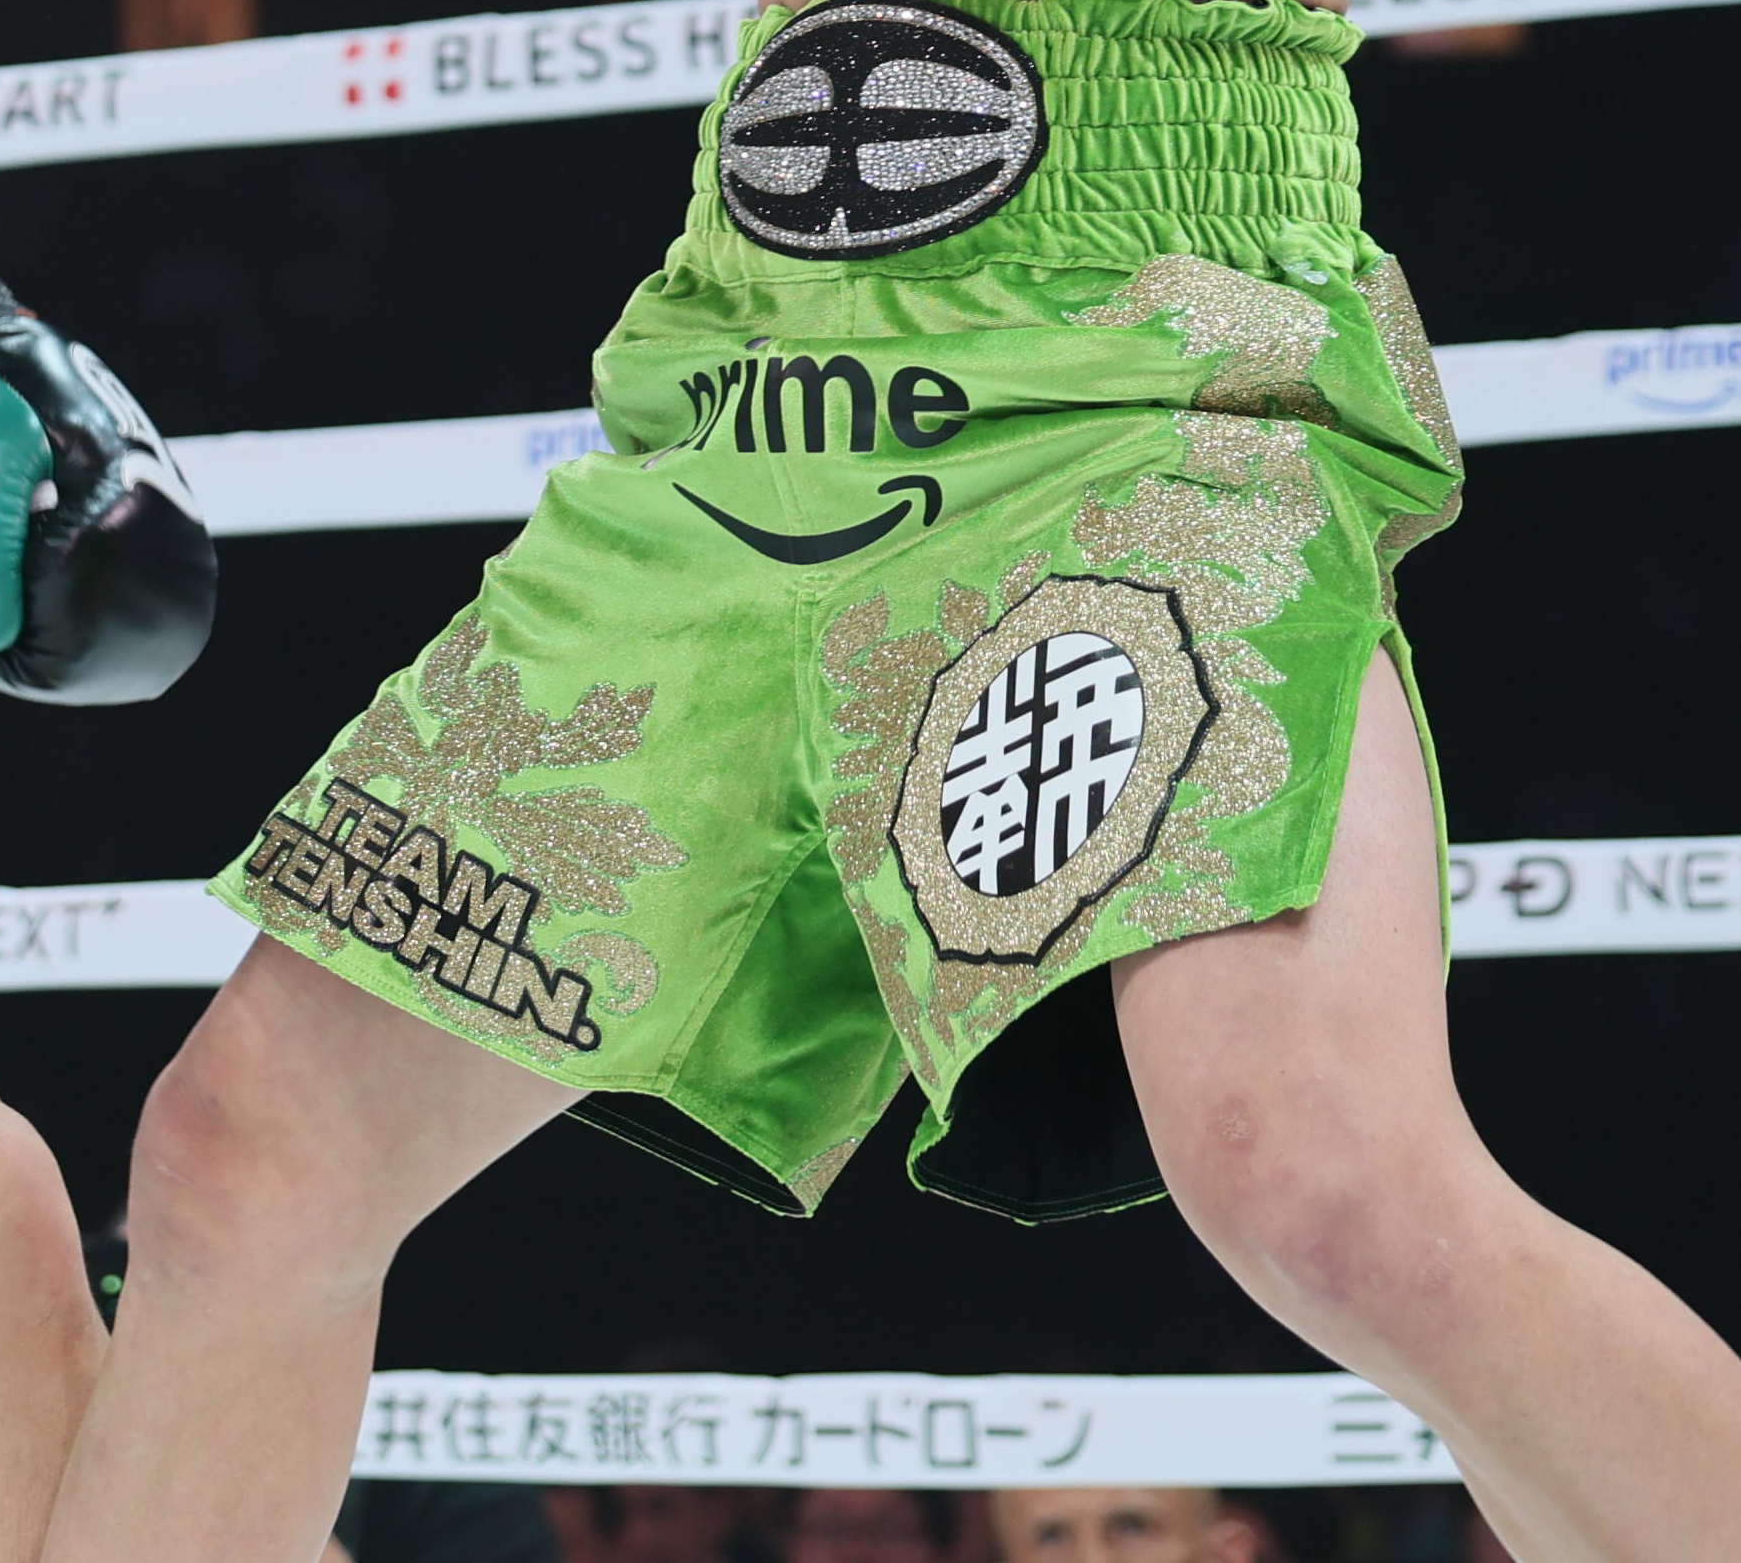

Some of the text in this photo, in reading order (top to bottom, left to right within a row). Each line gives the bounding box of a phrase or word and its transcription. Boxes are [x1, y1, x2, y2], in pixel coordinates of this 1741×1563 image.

[432, 15, 658, 95] BLESS
[321, 775, 542, 955] TEAM
[371, 1391, 1096, 1468] 井住友銀行 カードローン
